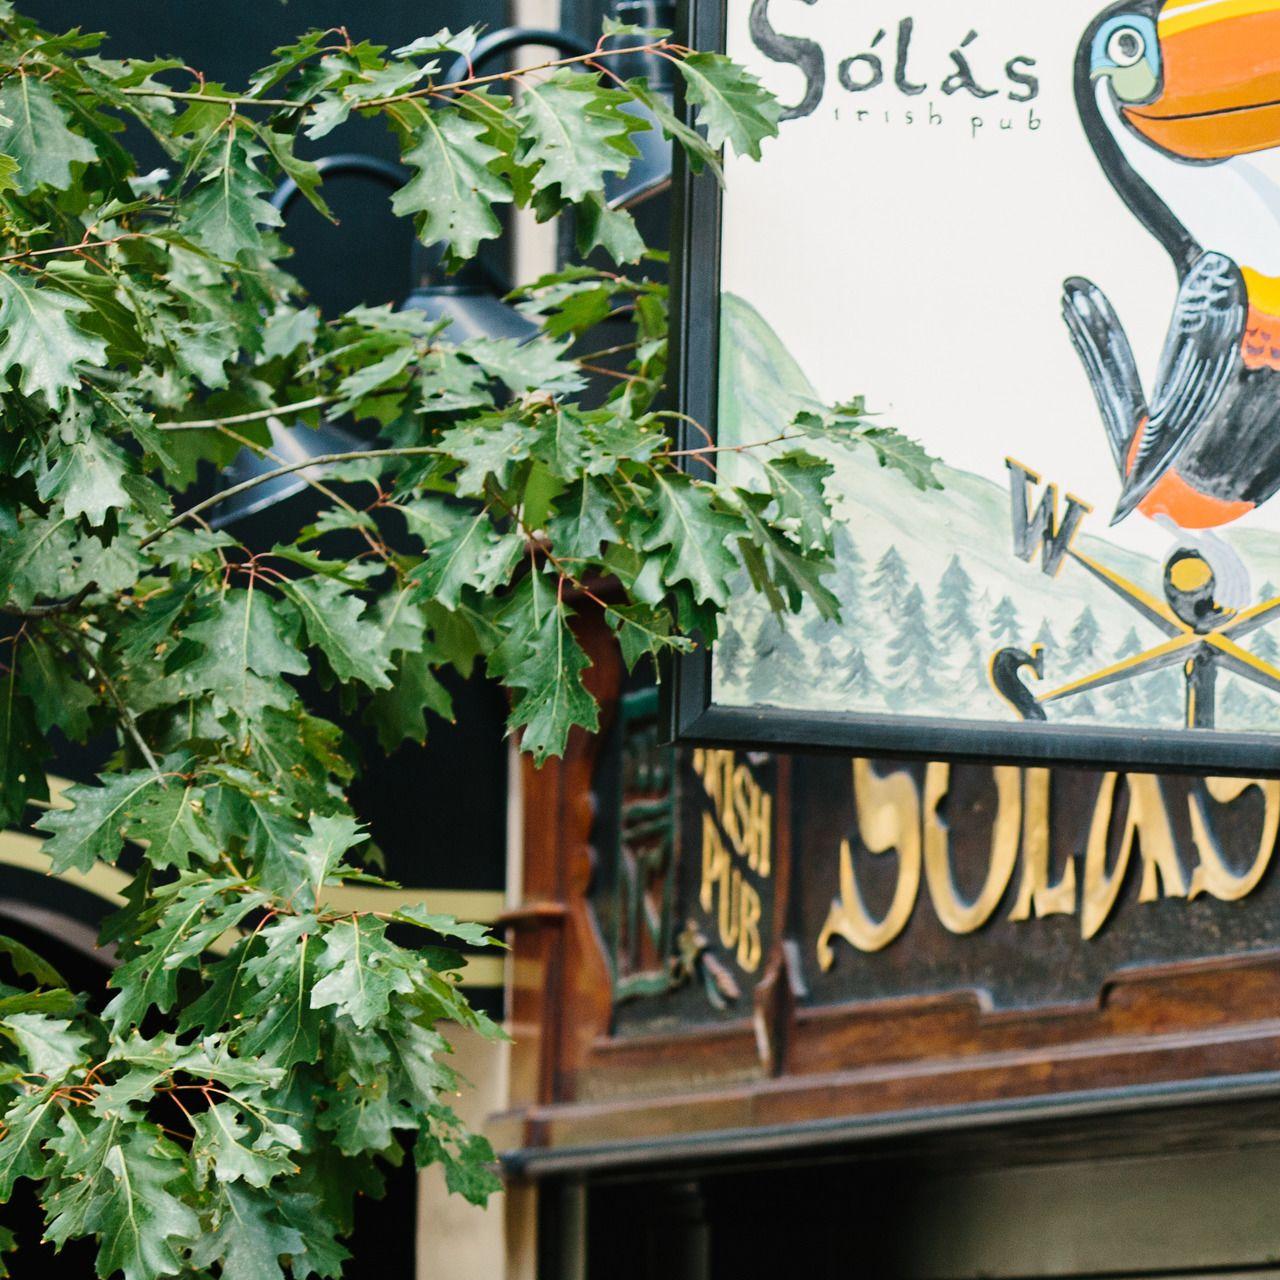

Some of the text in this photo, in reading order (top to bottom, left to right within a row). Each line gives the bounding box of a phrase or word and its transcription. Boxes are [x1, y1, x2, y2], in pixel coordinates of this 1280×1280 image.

[749, 0, 1039, 122] Sólás
[834, 102, 1041, 138] irish pub
[1005, 456, 1093, 577] W
[700, 810, 762, 974] PUB
